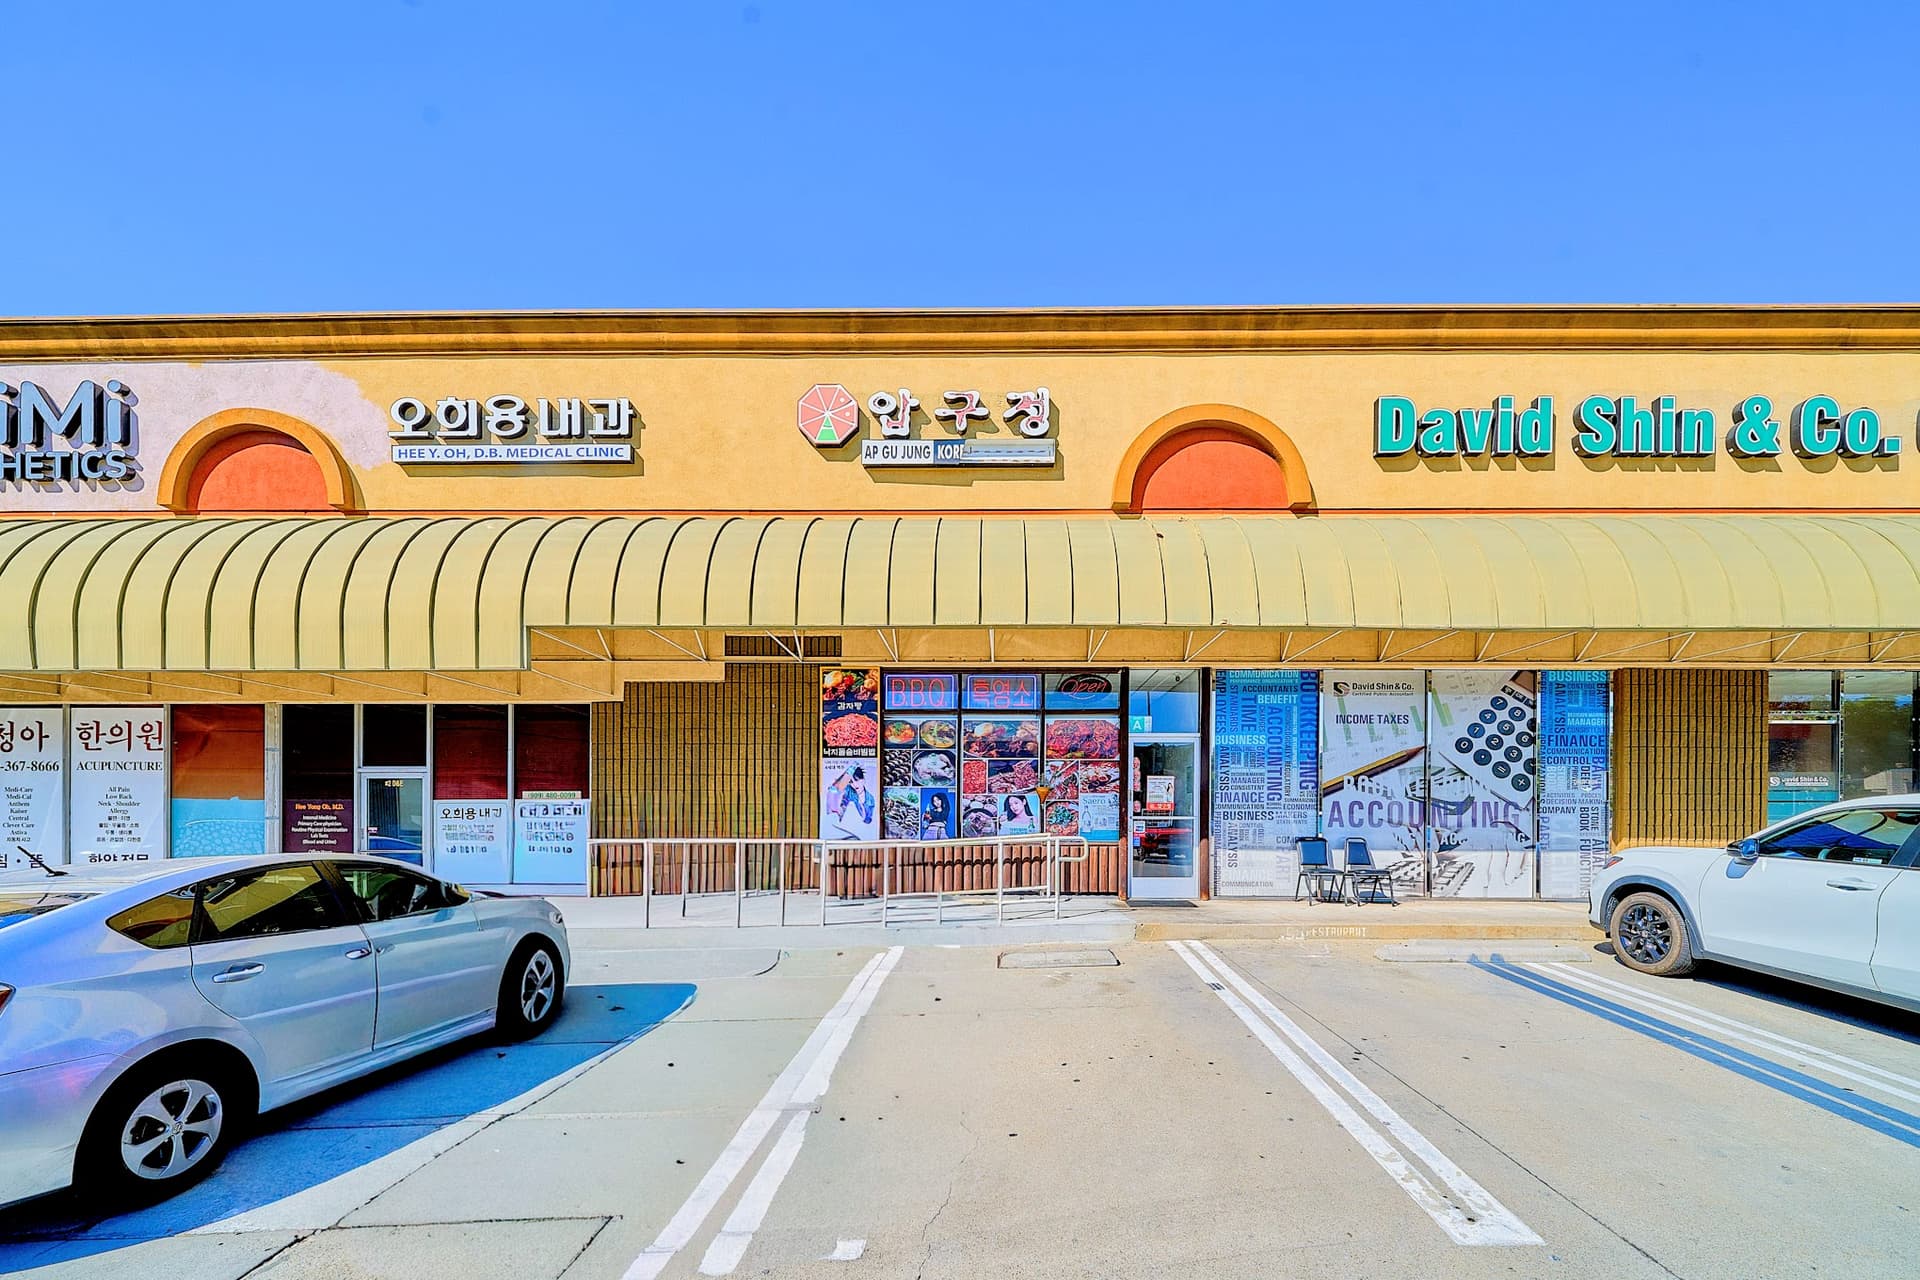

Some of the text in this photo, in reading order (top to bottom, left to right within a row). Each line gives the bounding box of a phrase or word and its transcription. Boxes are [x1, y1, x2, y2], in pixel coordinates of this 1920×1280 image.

[388, 394, 634, 438] 오희용내과
[868, 387, 1049, 438] 압구정
[1378, 395, 1902, 455] David Shin & Co.
[397, 446, 625, 461] HEE Y. OH, D.B. MEDICAL CLINIC
[864, 445, 879, 460] AP
[882, 445, 898, 460] GU
[901, 445, 931, 460] JUNG
[1229, 670, 1299, 680] COMMUNICATION
[1548, 671, 1607, 682] BUSINESS
[973, 679, 1034, 708] 흑염소
[1061, 679, 1107, 697] Open
[1242, 685, 1299, 693] ACCOUNTANTS
[1352, 682, 1415, 690] David Shin & Co.
[1215, 670, 1227, 734] EMPLOYEES
[1257, 694, 1299, 704] BENEFIT
[1241, 695, 1257, 732] TIME
[1554, 683, 1566, 734] ANALYSIS
[1133, 720, 1142, 730] A
[1335, 714, 1410, 724] INCOME TAXES
[75, 720, 164, 752] 한의원
[1300, 671, 1318, 790] BOOKKEEPING
[1215, 735, 1267, 745] BUSINESS
[1547, 734, 1605, 747] FINANCE
[1267, 706, 1283, 801] ACCOUNTING
[1546, 756, 1592, 765] CONTROL
[76, 761, 163, 771] ACUPUNCTURE
[1219, 745, 1230, 791] ANALYSIS
[1214, 791, 1265, 803] FINANCE
[1222, 811, 1275, 821] BUSINESS
[1327, 800, 1522, 828] ACCOUNTING
[1579, 806, 1590, 832] BOOK
[1227, 822, 1239, 869] ANALYSIS
[1579, 838, 1592, 897] FUNCTIONS
